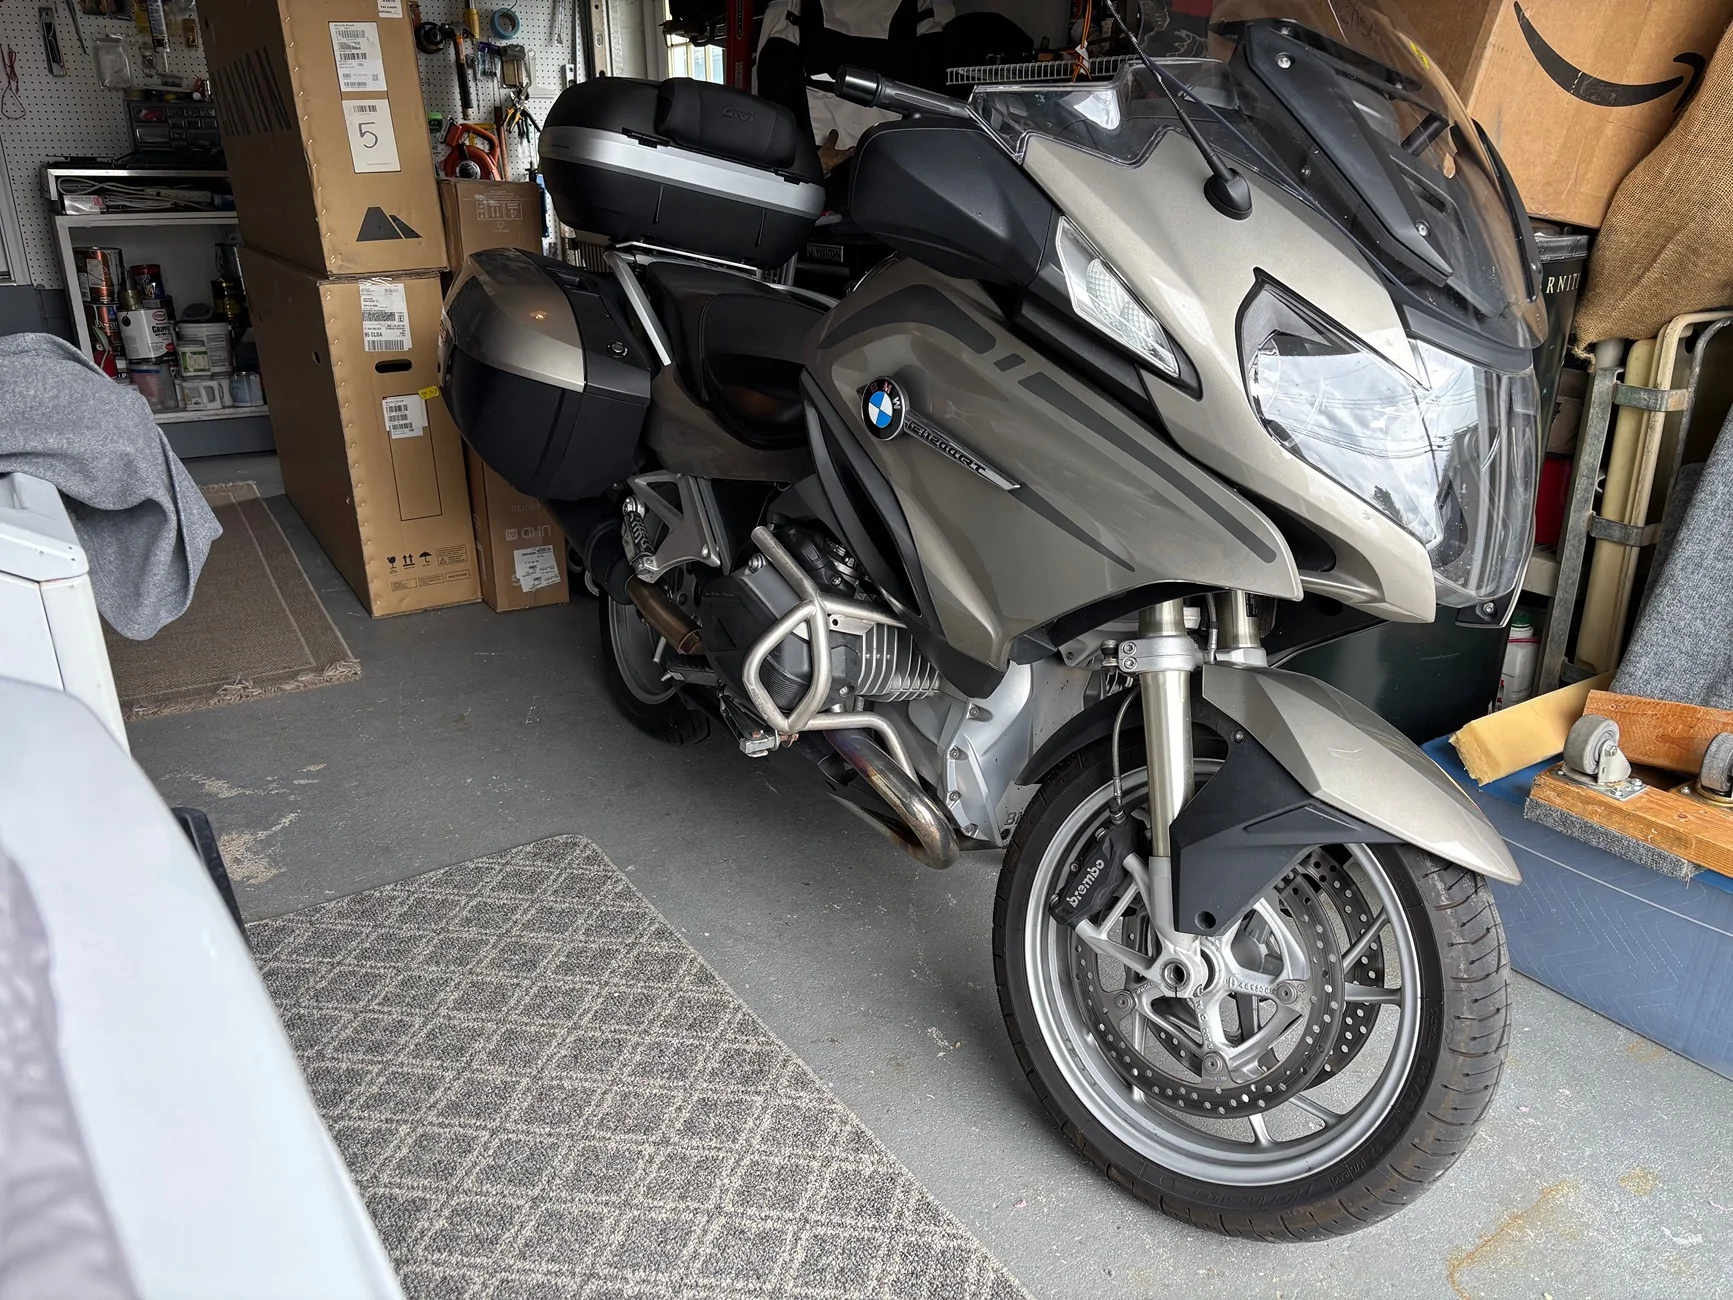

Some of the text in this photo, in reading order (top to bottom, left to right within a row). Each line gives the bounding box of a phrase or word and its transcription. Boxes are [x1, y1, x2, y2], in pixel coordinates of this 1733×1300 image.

[721, 104, 755, 123] GIVI
[358, 121, 378, 149] 5
[870, 381, 902, 410] BMW
[521, 524, 552, 539] UHD
[1066, 859, 1105, 908] brembo
